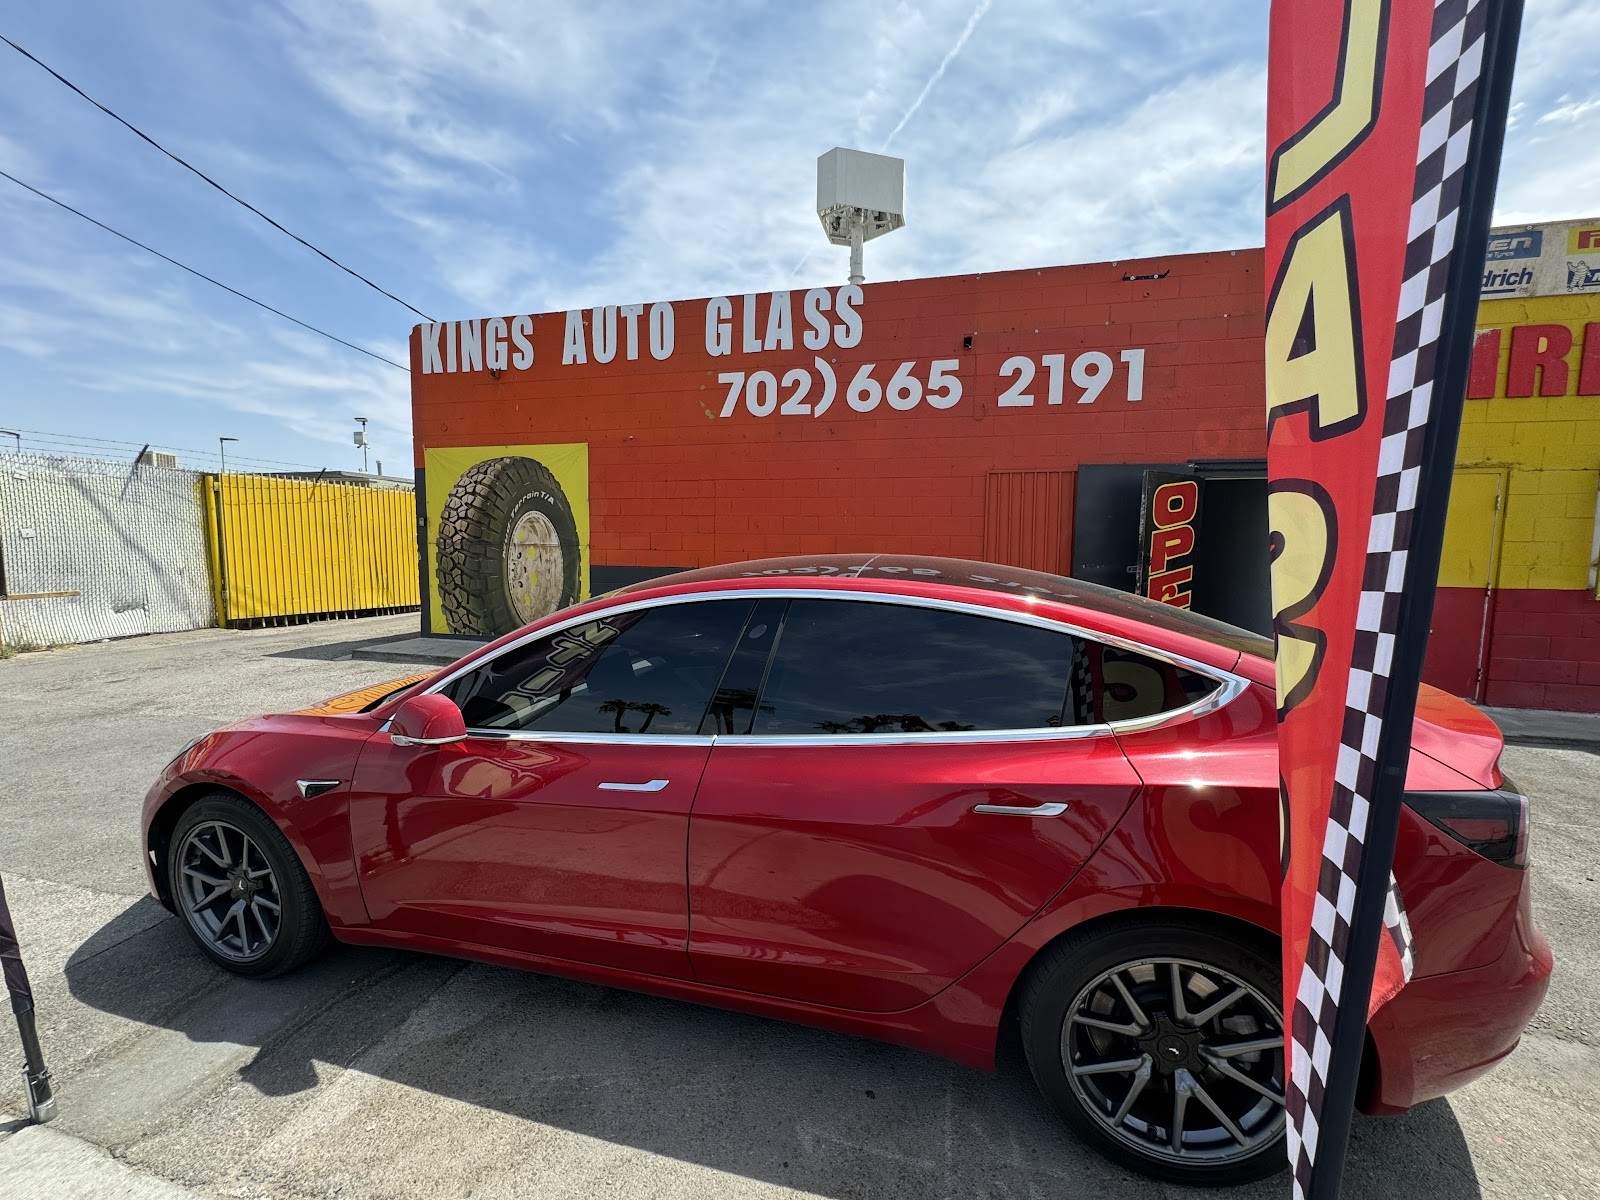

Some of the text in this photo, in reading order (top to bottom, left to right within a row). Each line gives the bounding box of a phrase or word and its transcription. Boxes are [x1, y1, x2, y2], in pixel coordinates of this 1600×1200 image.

[421, 284, 865, 375] KINGS AUTO GLASS
[997, 348, 1146, 408] 2191
